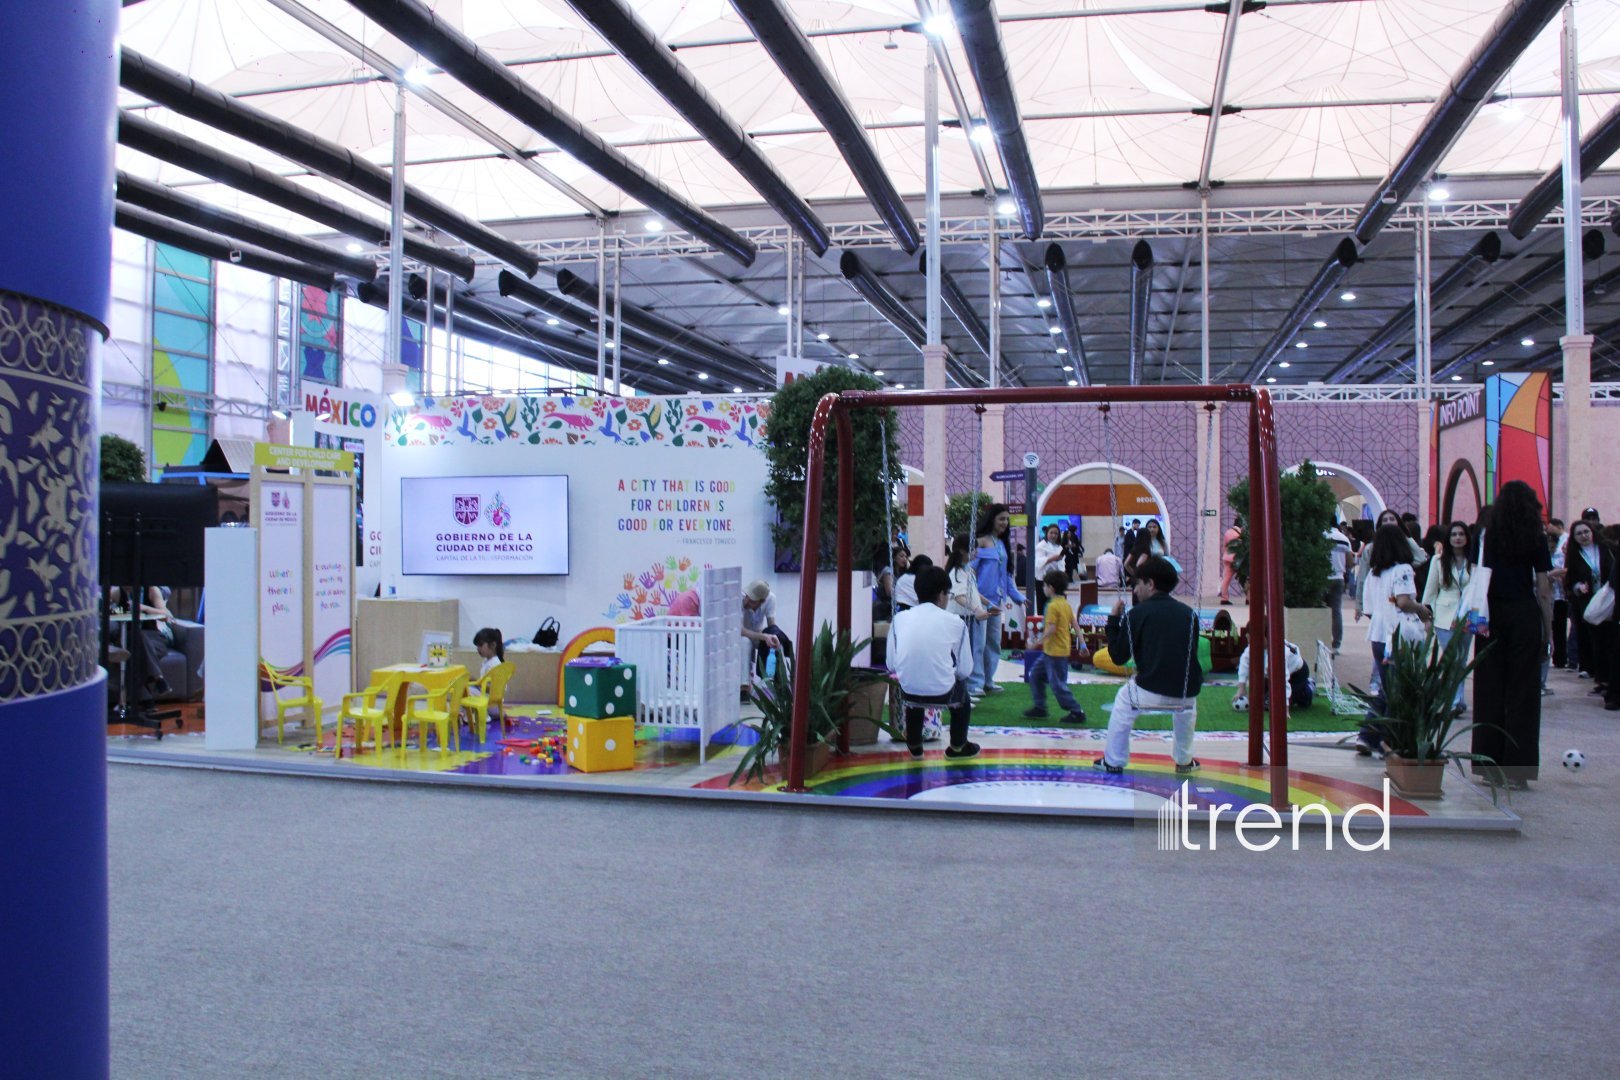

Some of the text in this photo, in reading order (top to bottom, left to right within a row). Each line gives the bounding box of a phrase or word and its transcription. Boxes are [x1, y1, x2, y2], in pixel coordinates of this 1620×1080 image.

[1457, 391, 1481, 421] POINT
[618, 479, 736, 493] A CITY THAT IS GOOD
[631, 499, 724, 512] FOR CHILDREN IS
[618, 518, 735, 531] GOOD FOR EVERYONE.
[436, 533, 533, 541] GOBIERNO DE LA
[436, 543, 533, 552] CIUDAD DE MÉXICO
